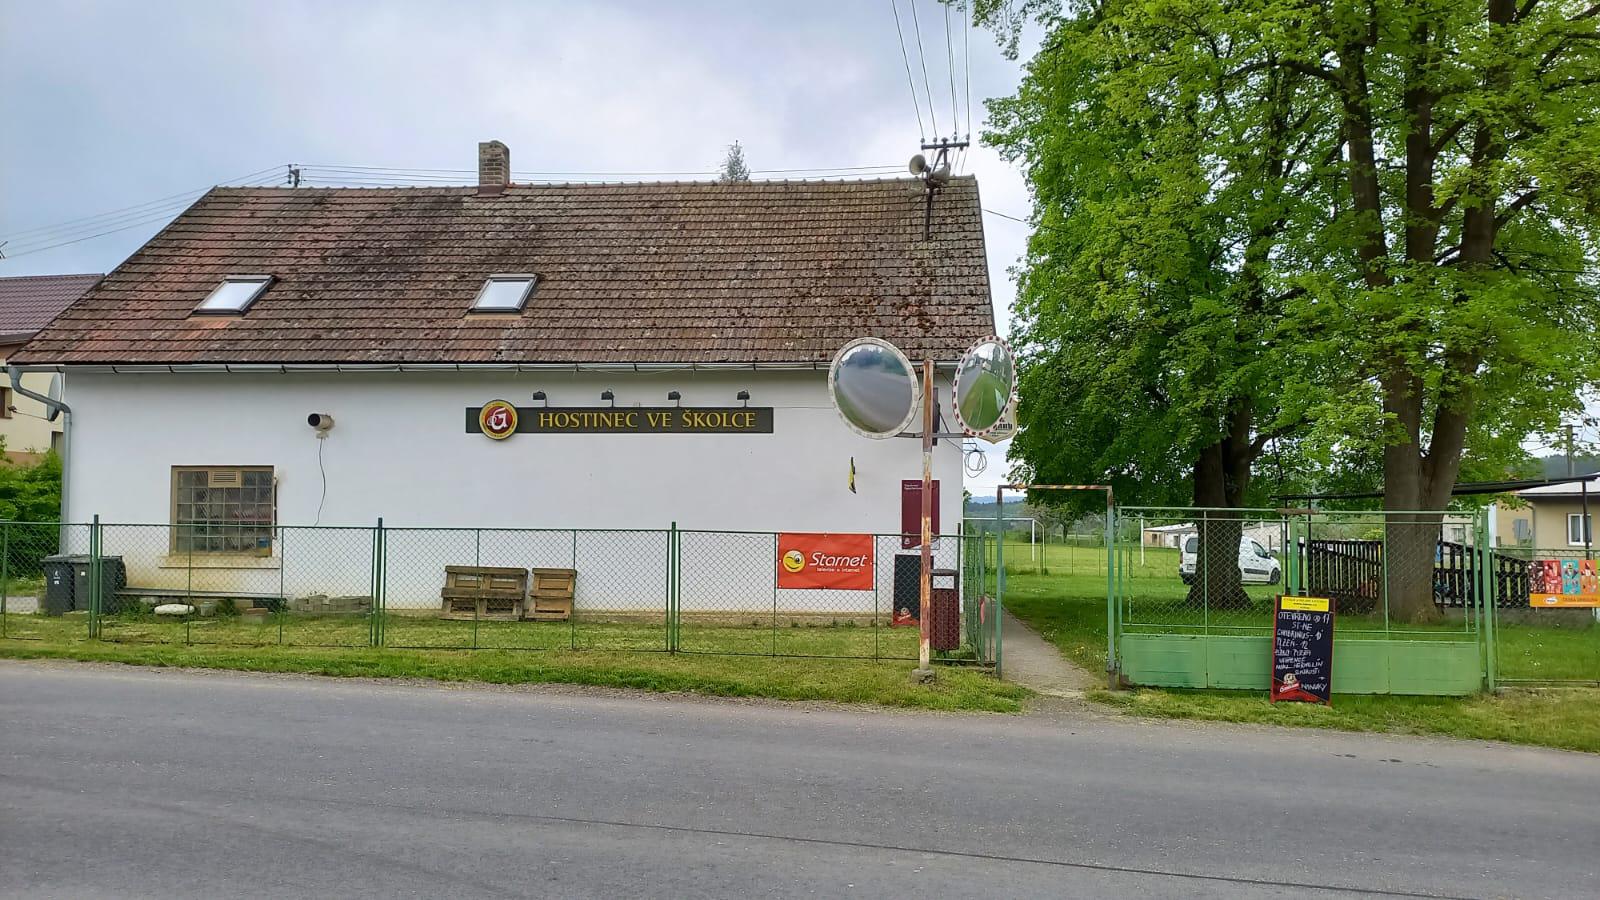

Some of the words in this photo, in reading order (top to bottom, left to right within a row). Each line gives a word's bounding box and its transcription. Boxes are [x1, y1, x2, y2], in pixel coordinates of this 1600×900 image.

[539, 412, 638, 428] HOSTINEC
[646, 412, 672, 428] VE
[682, 409, 756, 428] ŠKOLCE
[809, 552, 868, 567] Starnet
